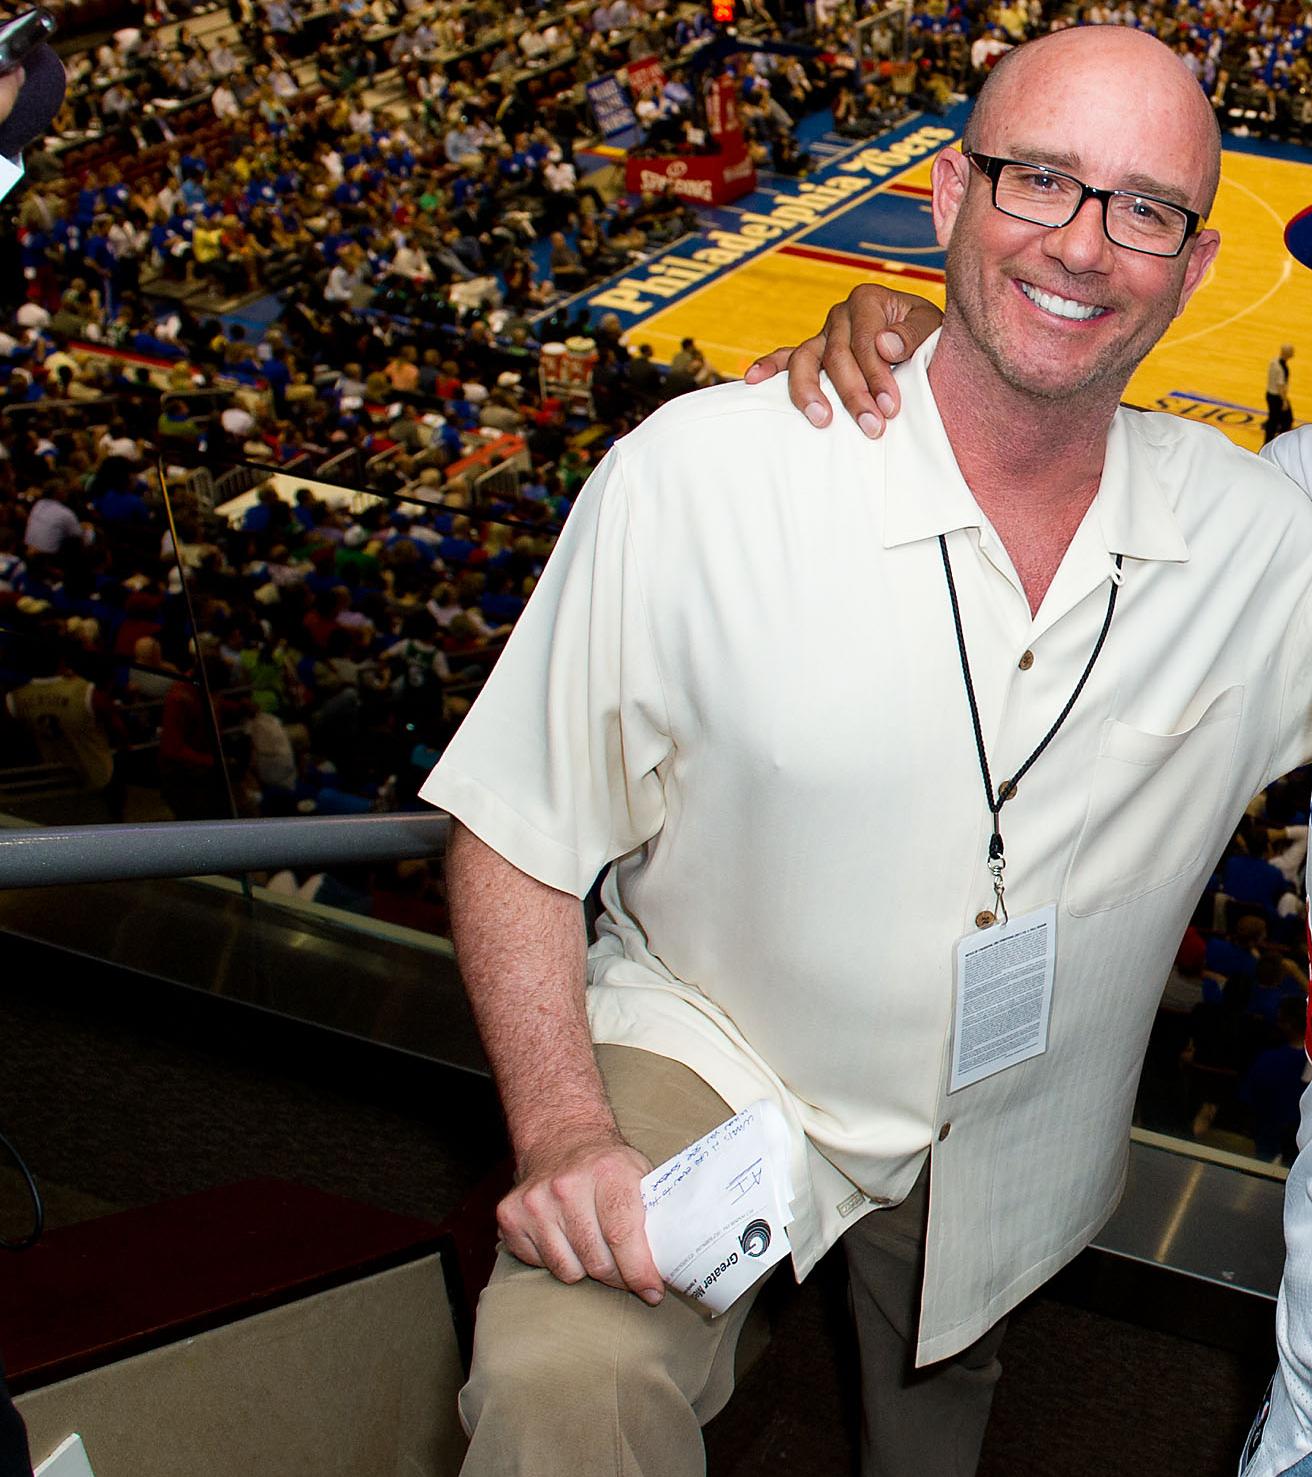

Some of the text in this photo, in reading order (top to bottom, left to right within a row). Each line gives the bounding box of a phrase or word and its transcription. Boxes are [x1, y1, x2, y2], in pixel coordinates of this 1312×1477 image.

[588, 126, 955, 315] Philadelphia 76ers
[703, 1252, 739, 1289] Greater
